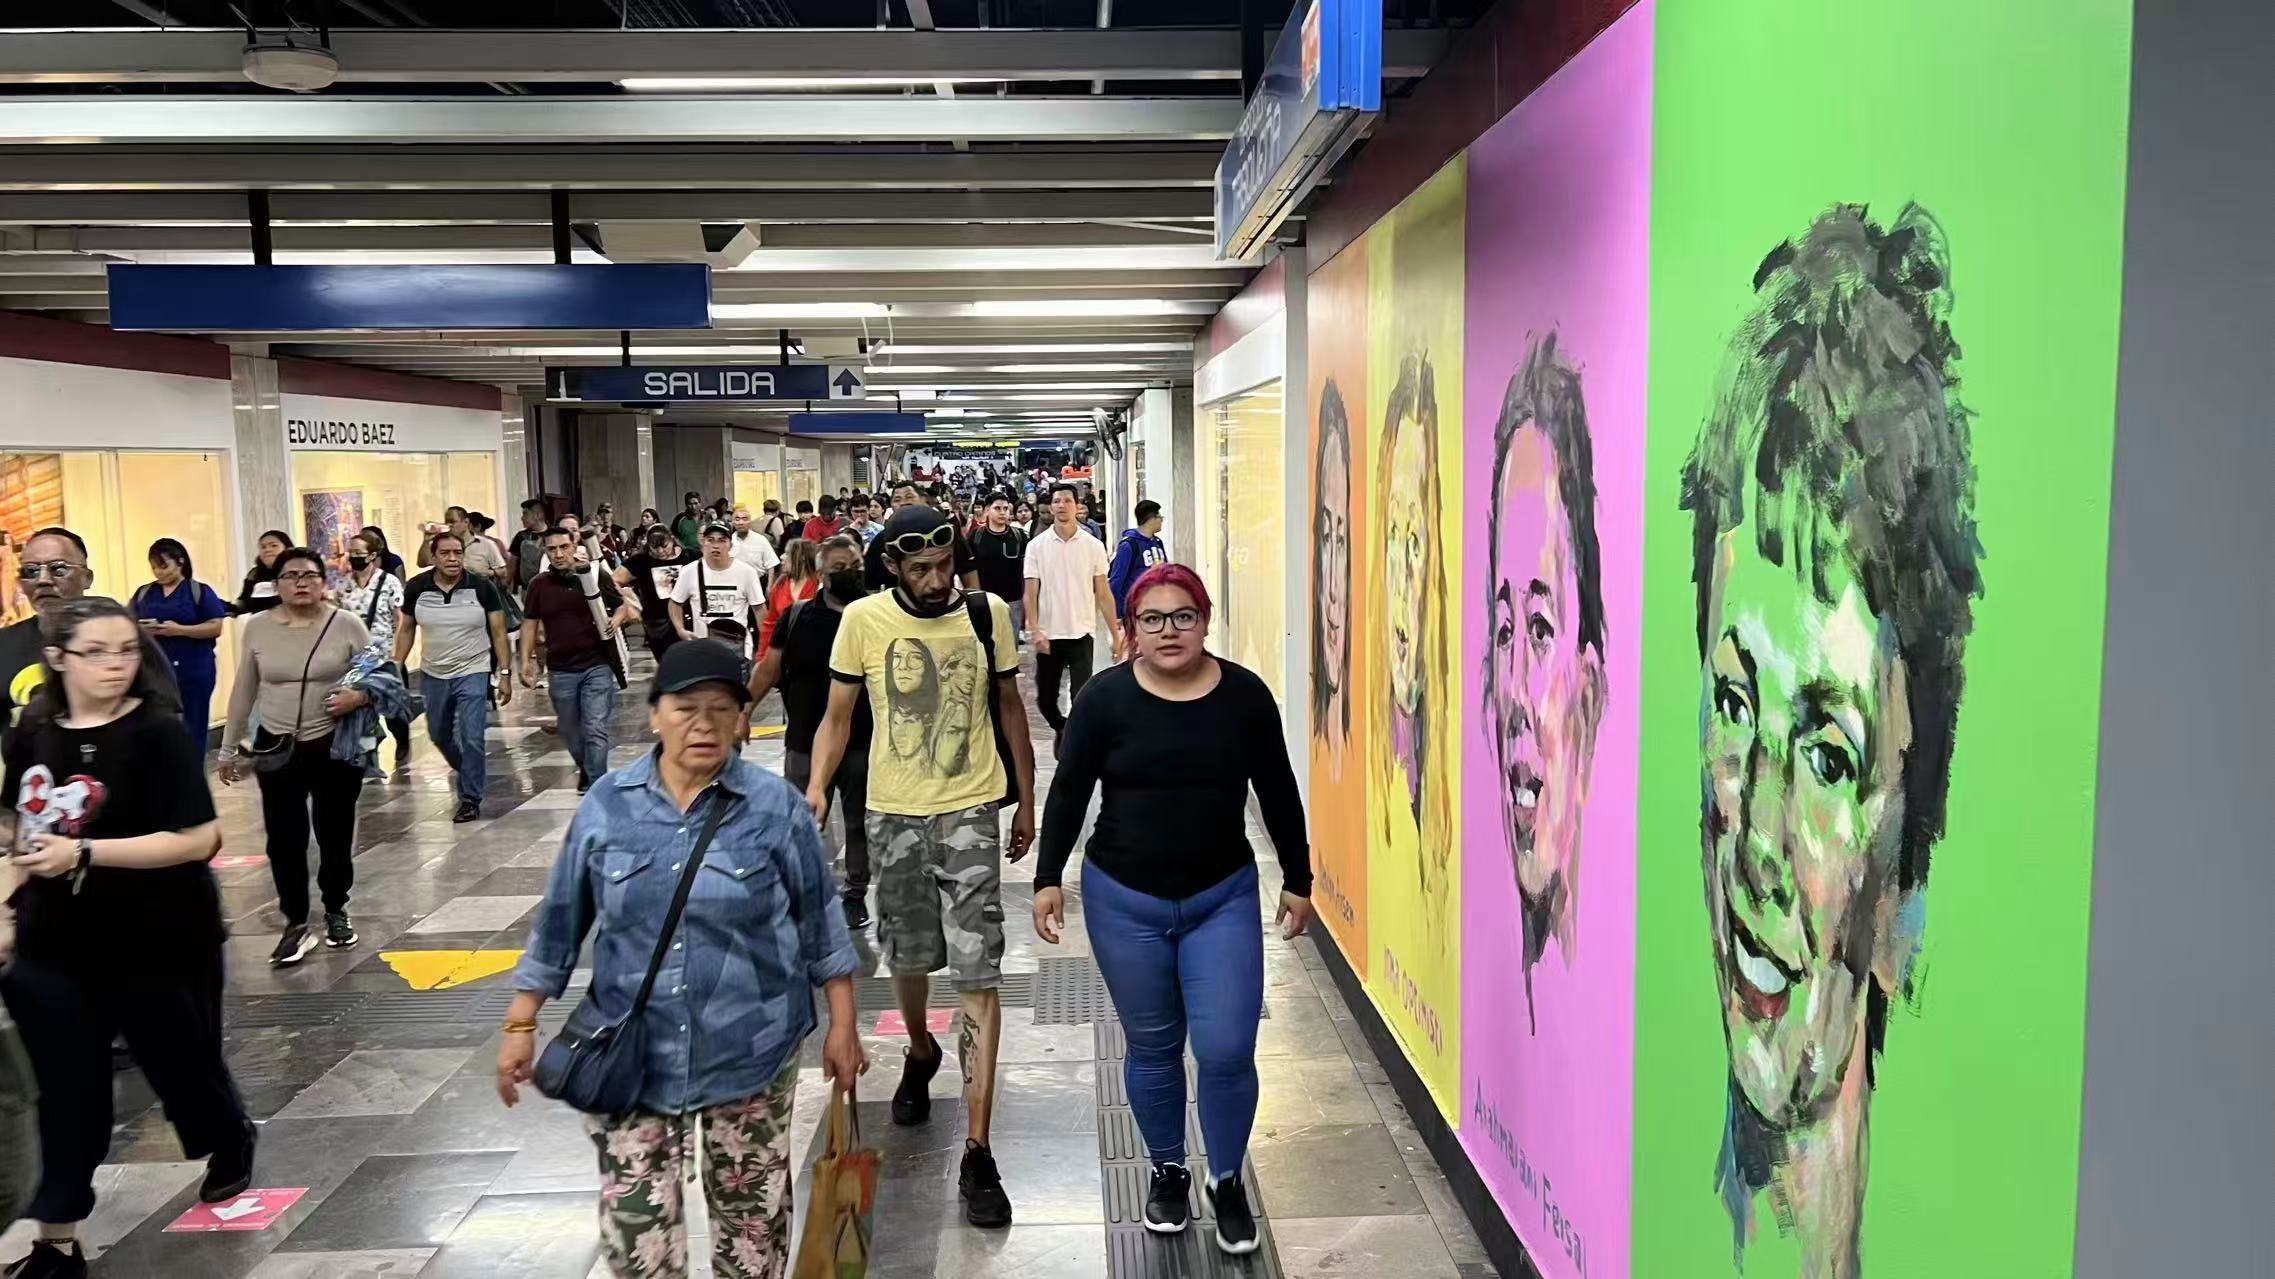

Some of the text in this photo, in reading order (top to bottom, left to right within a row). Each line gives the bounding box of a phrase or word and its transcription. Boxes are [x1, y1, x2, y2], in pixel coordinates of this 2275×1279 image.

[644, 370, 775, 396] SALIDA
[288, 419, 396, 445] EDUARDO BAEZ
[706, 592, 736, 603] alvin
